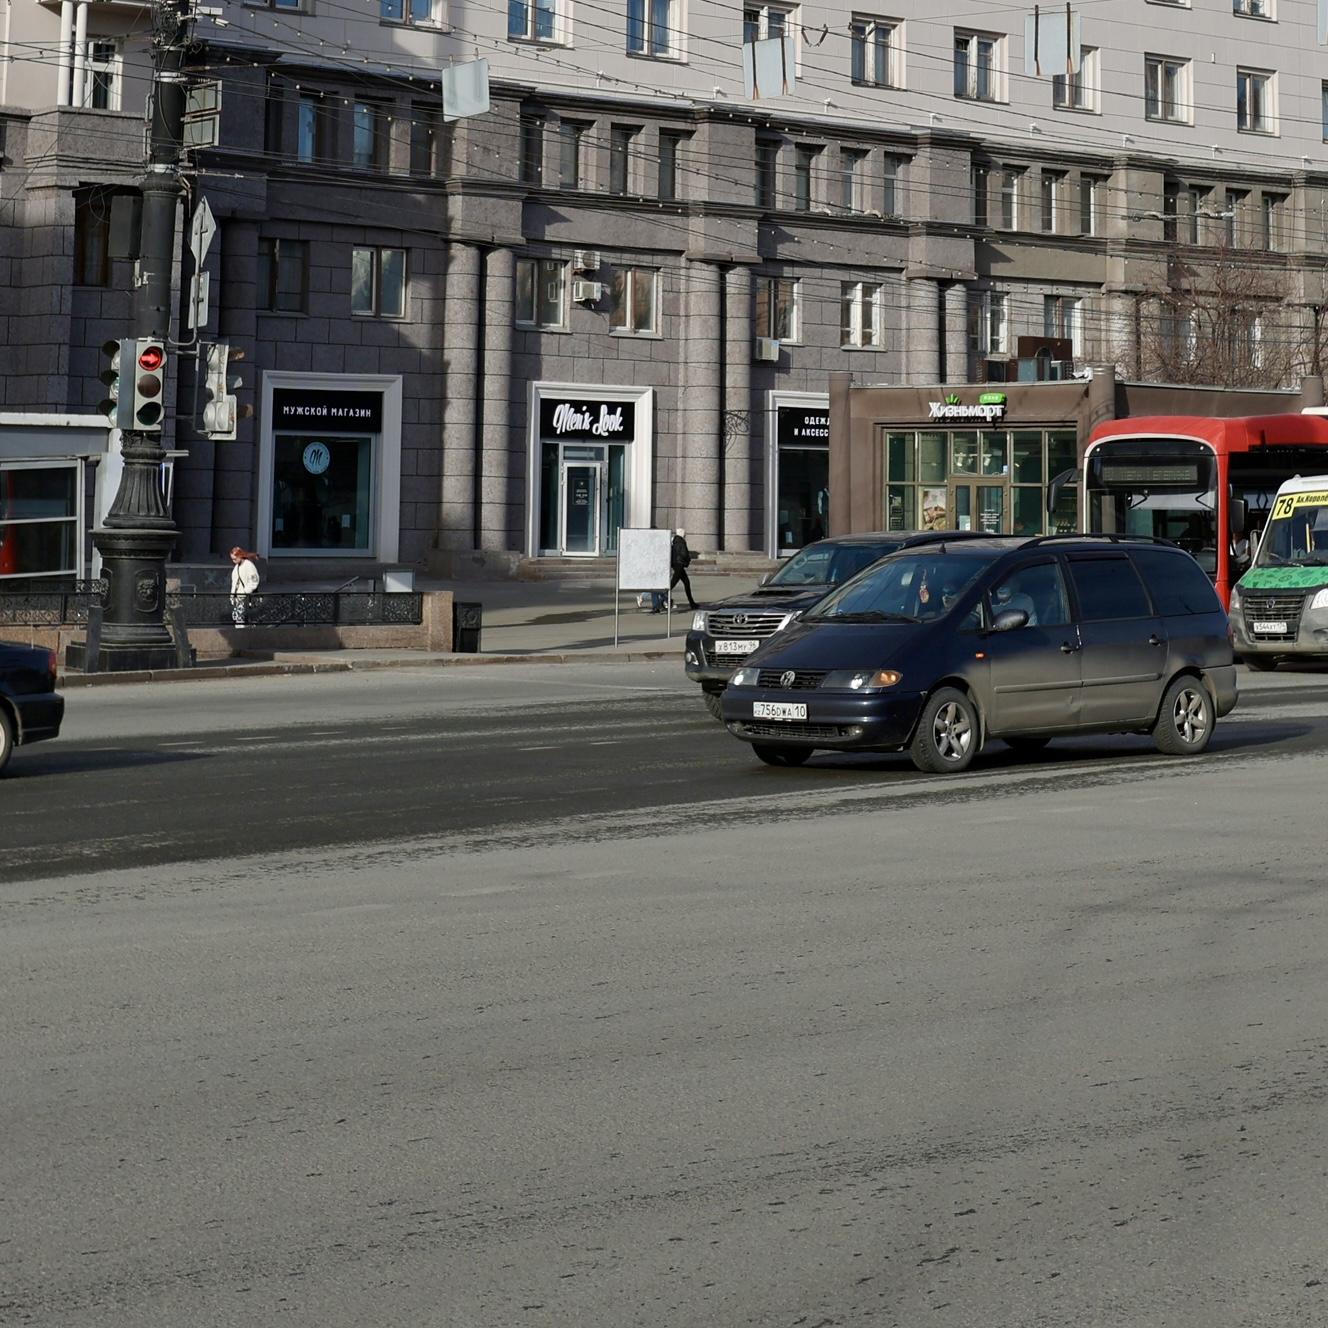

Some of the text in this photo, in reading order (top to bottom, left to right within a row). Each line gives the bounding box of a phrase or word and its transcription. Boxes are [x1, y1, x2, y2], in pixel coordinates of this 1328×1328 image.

[283, 405, 372, 417] МУЖСКОЙ МАГАЗИН
[592, 404, 624, 436] Look
[794, 428, 829, 437] И АКСЕСС
[1276, 497, 1294, 517] 78
